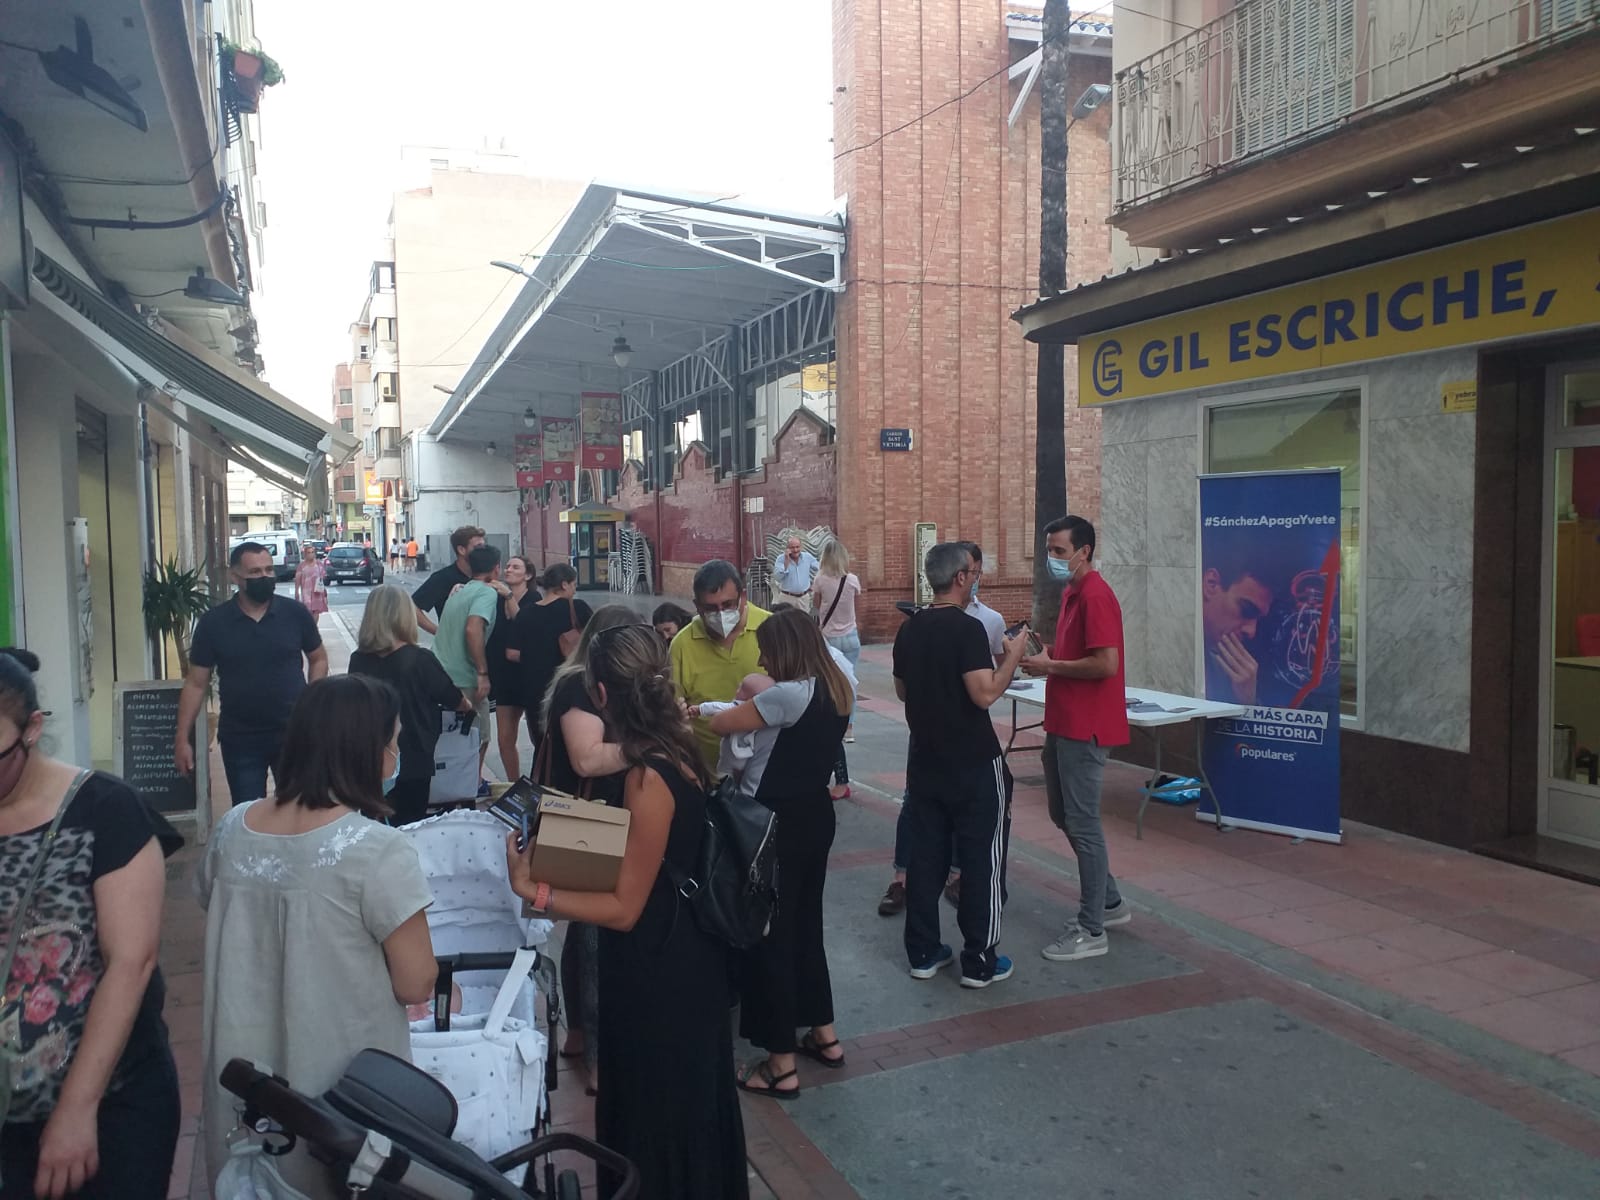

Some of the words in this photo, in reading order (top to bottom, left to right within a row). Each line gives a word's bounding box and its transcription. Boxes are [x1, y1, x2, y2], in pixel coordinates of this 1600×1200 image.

[1139, 332, 1209, 378] GIL
[1229, 259, 1557, 362] ESCRICHE,
[1204, 514, 1336, 528] #SánchezApagaYvete
[1253, 707, 1282, 721] MÁS
[1285, 711, 1323, 725] CARA
[1235, 722, 1251, 733] LA
[1253, 724, 1317, 740] HISTORIA
[1241, 747, 1295, 761] populares
